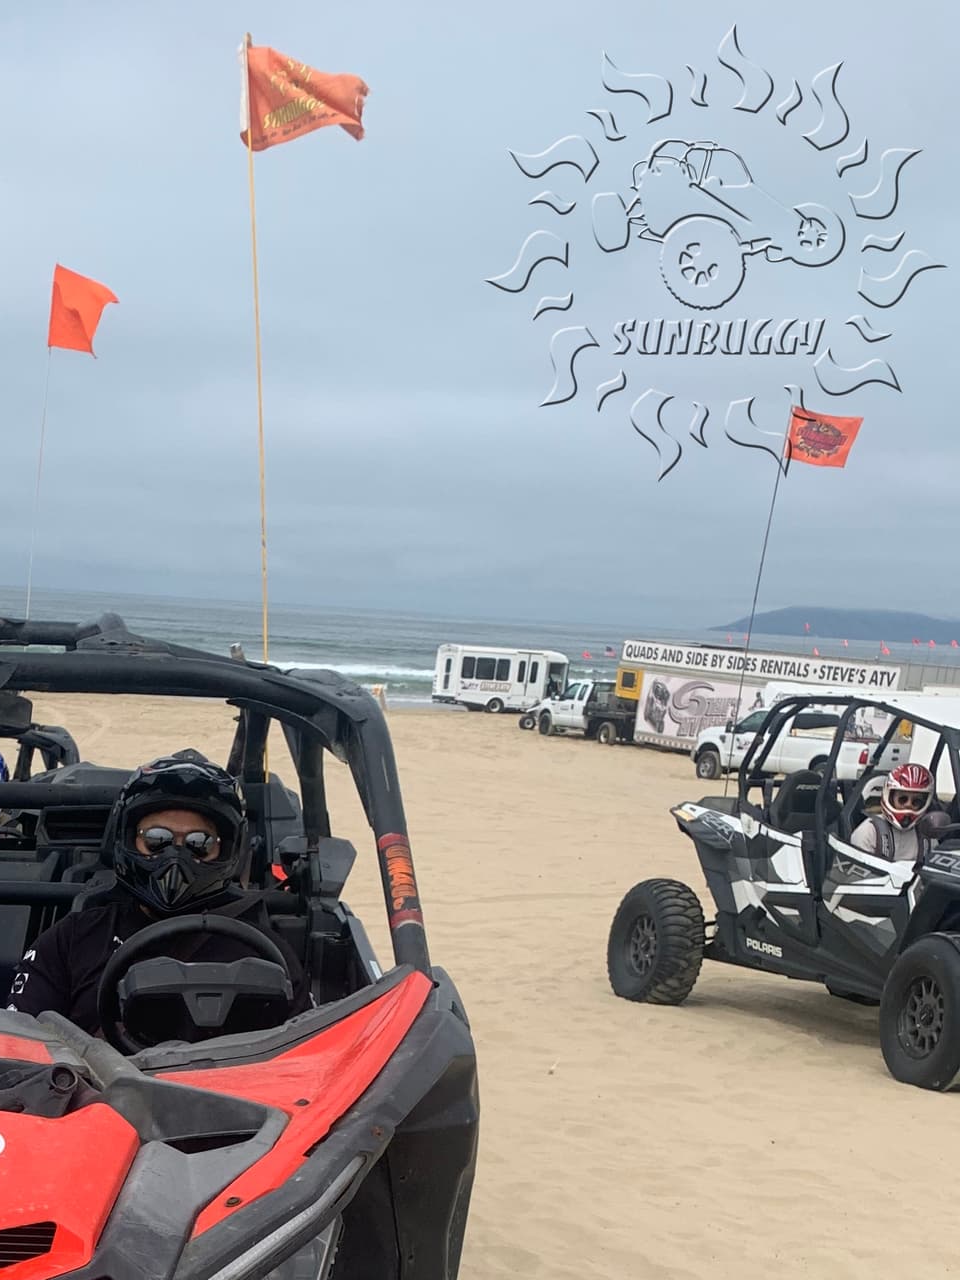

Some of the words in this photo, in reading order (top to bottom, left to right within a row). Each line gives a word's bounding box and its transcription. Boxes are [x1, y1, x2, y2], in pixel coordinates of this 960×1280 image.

[625, 644, 659, 662] QUADS
[660, 648, 683, 664] AND
[685, 651, 709, 668] SIDE
[710, 654, 726, 670] BY
[726, 655, 757, 673] SIDES
[760, 660, 809, 678] RENTALS
[818, 664, 866, 685] STEVE'S
[869, 669, 897, 687] ATV
[832, 855, 871, 878] XP
[746, 938, 783, 957] POLARIS
